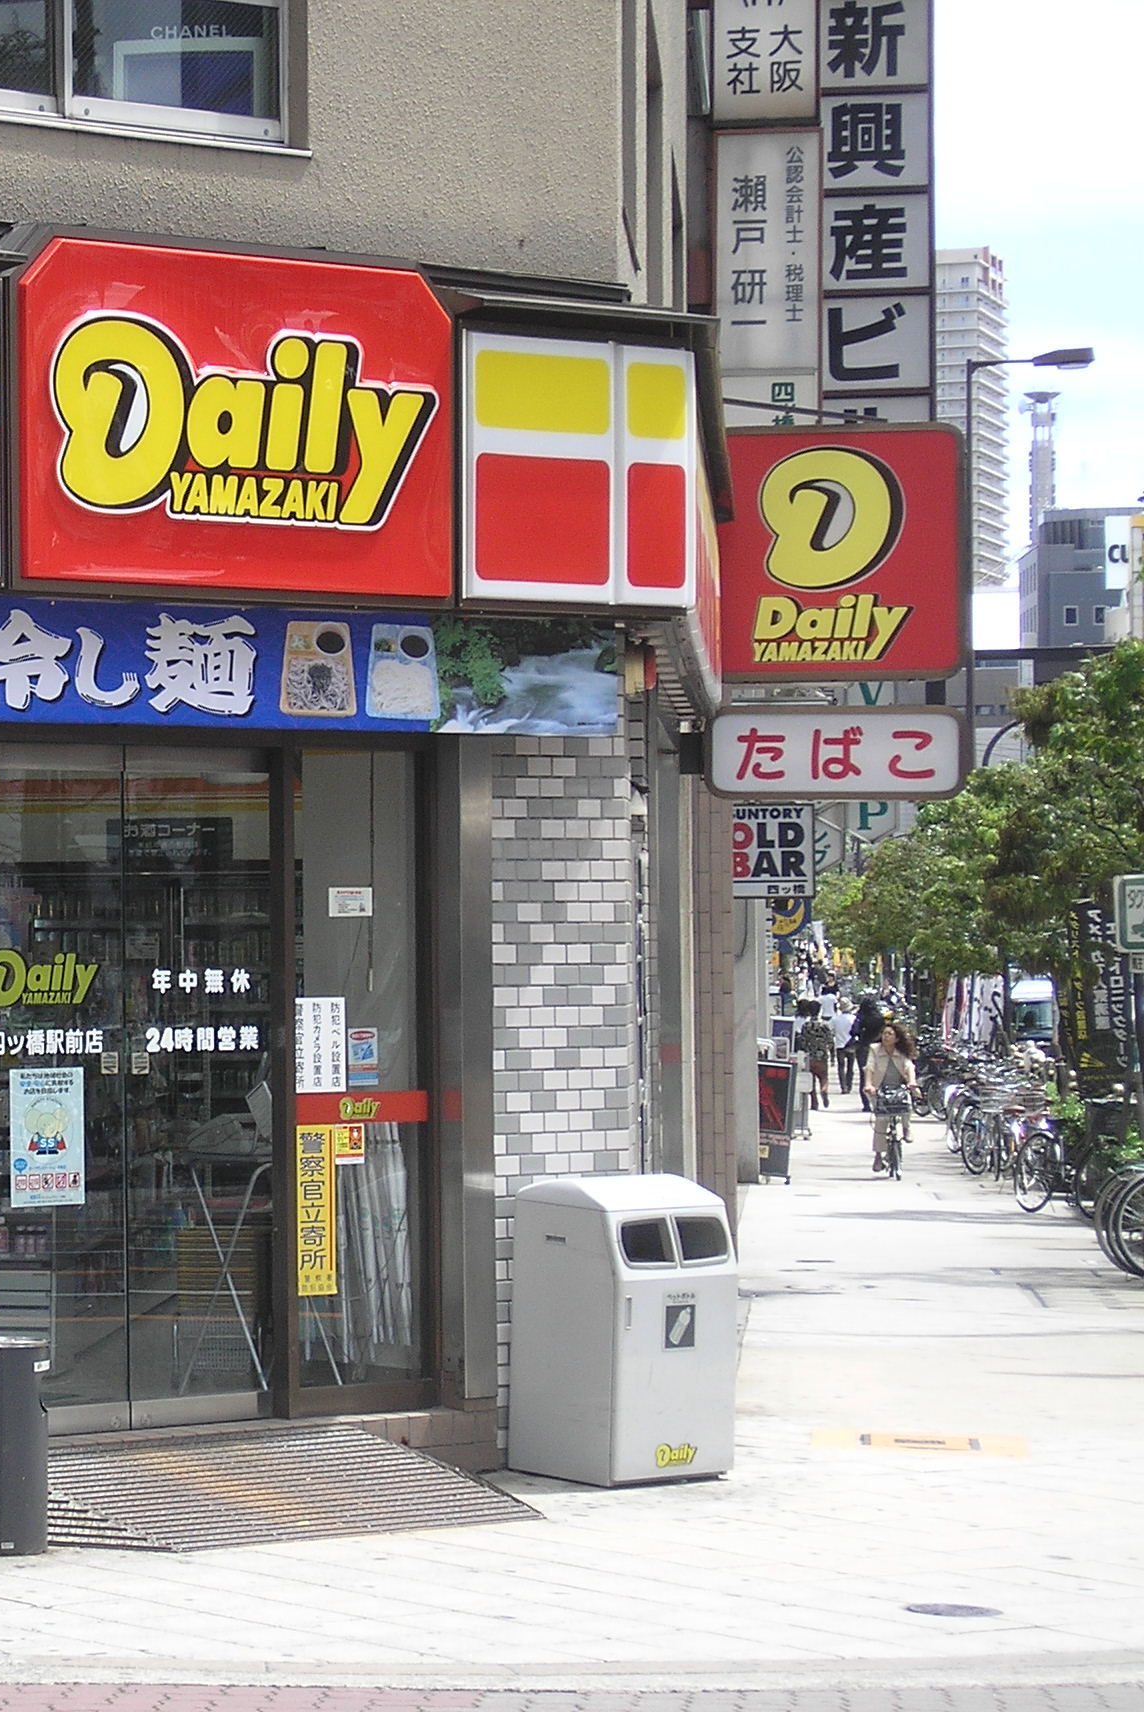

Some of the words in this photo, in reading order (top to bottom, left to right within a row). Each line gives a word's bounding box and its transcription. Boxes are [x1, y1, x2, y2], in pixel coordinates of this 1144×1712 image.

[150, 24, 232, 40] CHANEL
[726, 27, 761, 95] 支社
[769, 25, 804, 93] 大阪
[52, 315, 436, 528] Daily
[169, 471, 341, 523] YAMAZAKI
[754, 593, 912, 661] Daily
[753, 641, 866, 662] YAMAZAKI
[736, 726, 936, 780] たばこ
[733, 808, 804, 820] UNTORY
[733, 822, 806, 850] OLD
[733, 850, 807, 878] BAR
[152, 968, 251, 994] 年中無休
[21, 993, 73, 1005] YAMAZAKI
[145, 1026, 260, 1054] 24時間営業
[340, 1097, 381, 1119] Daily
[300, 1132, 327, 1271] 警察官立寄所
[656, 1443, 697, 1468] Daily
